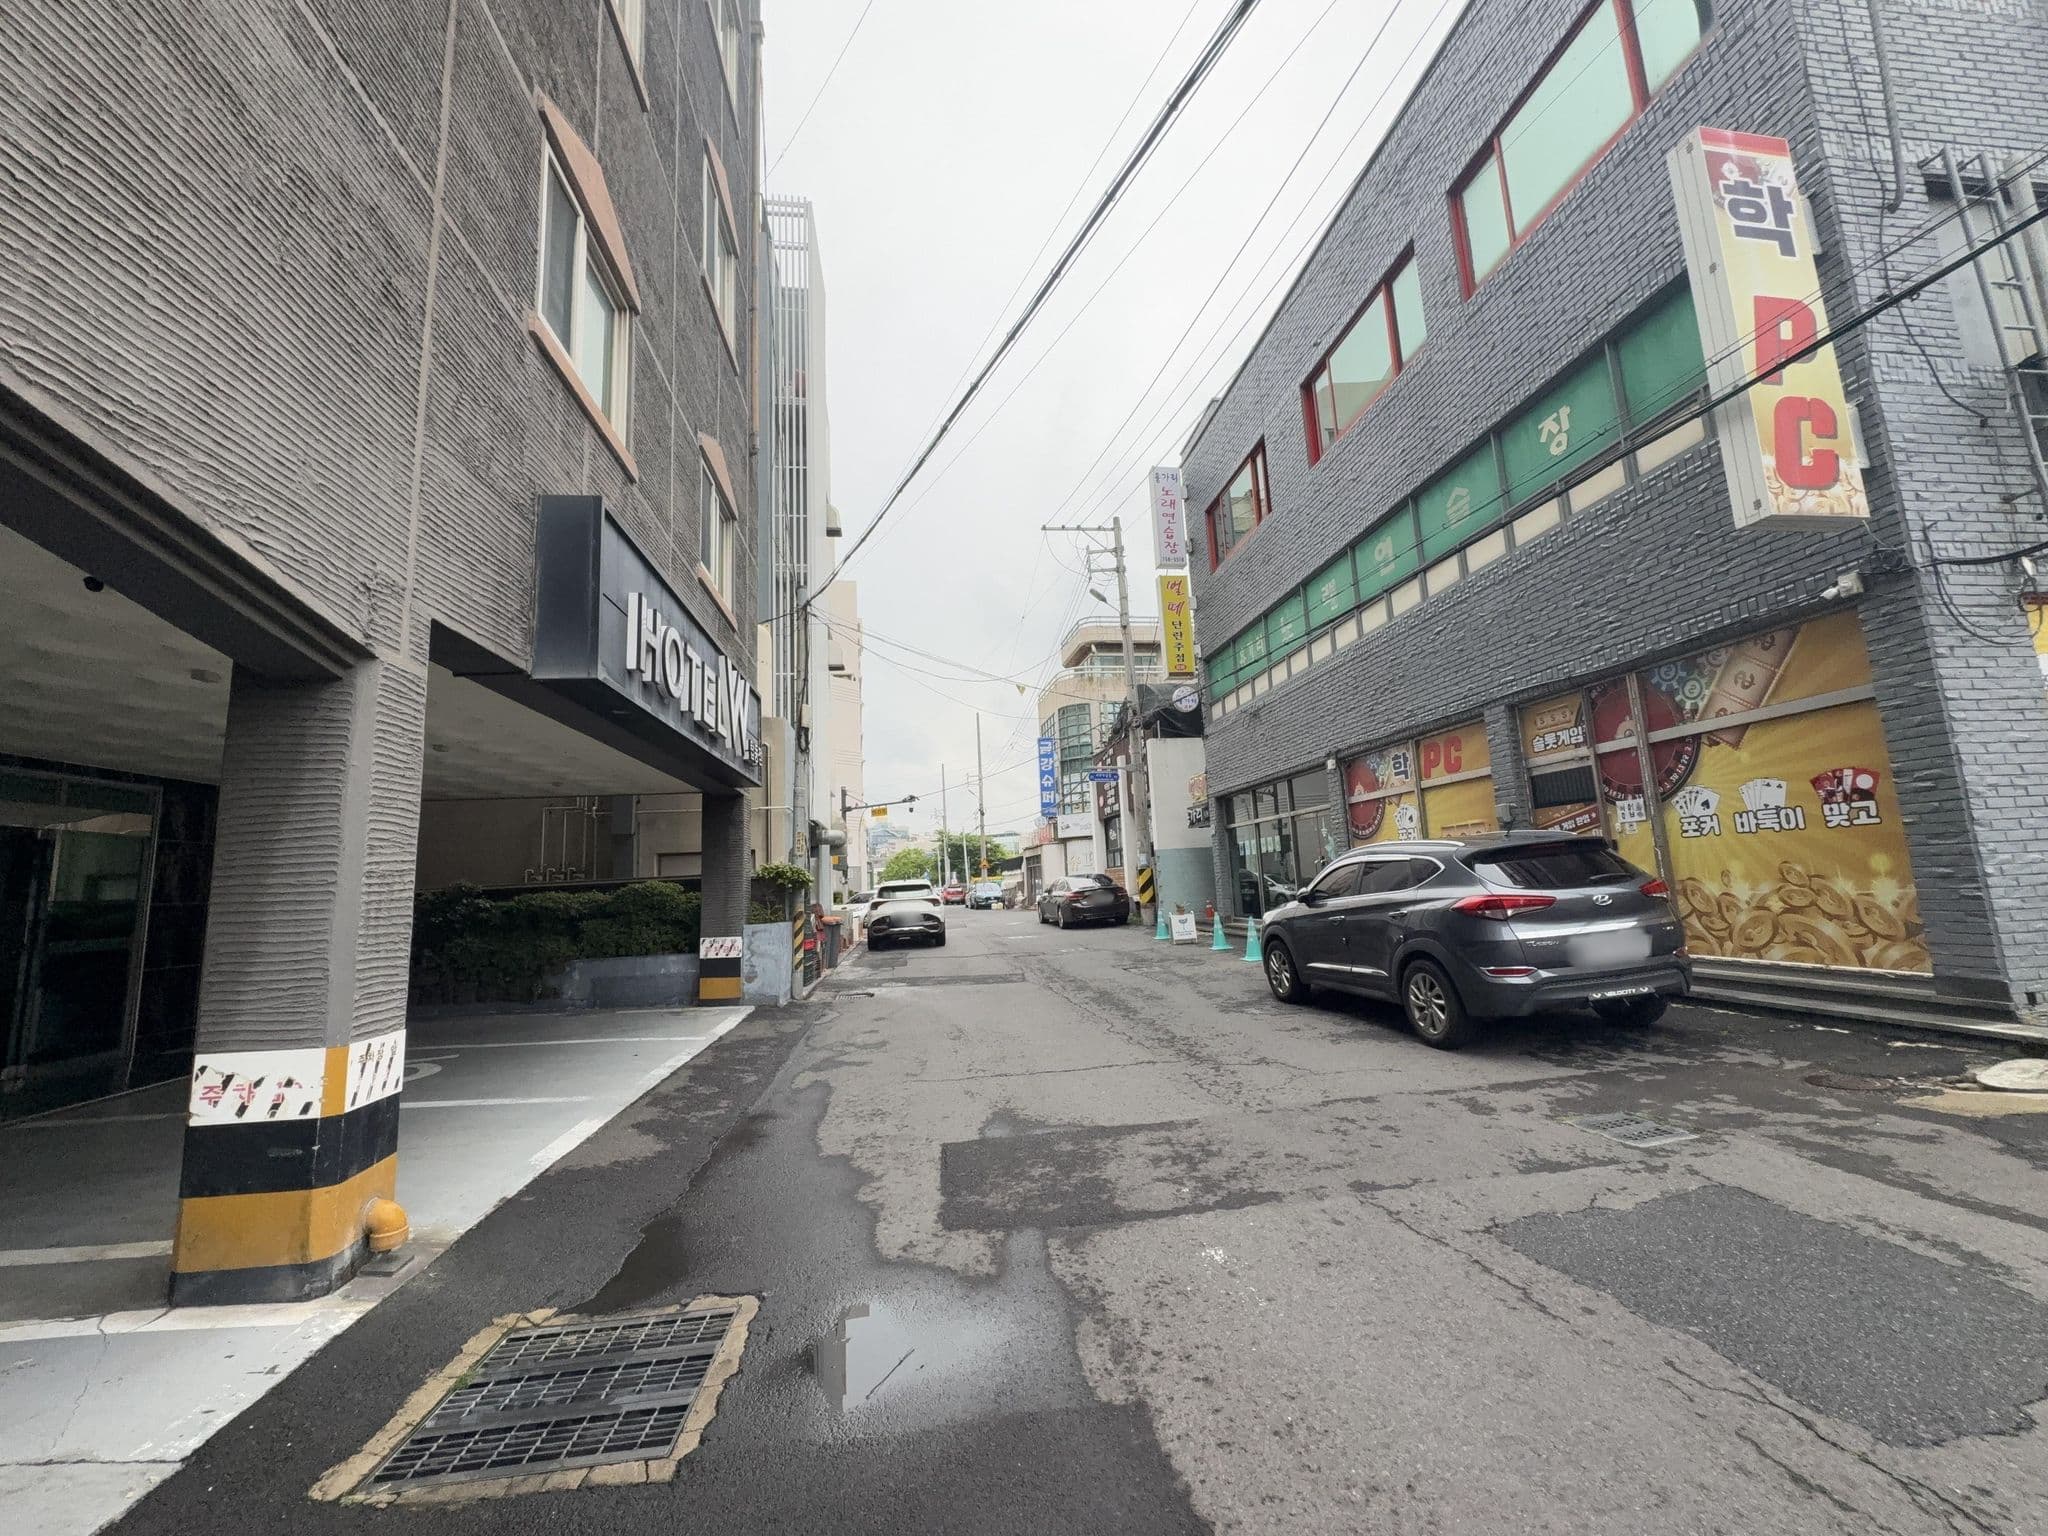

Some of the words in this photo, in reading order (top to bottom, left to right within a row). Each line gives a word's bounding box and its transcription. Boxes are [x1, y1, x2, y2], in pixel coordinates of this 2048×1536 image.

[1751, 293, 1844, 492] PC
[1160, 486, 1179, 554] 노래연습장
[1390, 751, 1412, 781] 학
[1423, 735, 1462, 779] PC
[1680, 814, 1721, 838] 포커
[1734, 806, 1806, 833] 바둑이
[1822, 801, 1882, 827] 맞고
